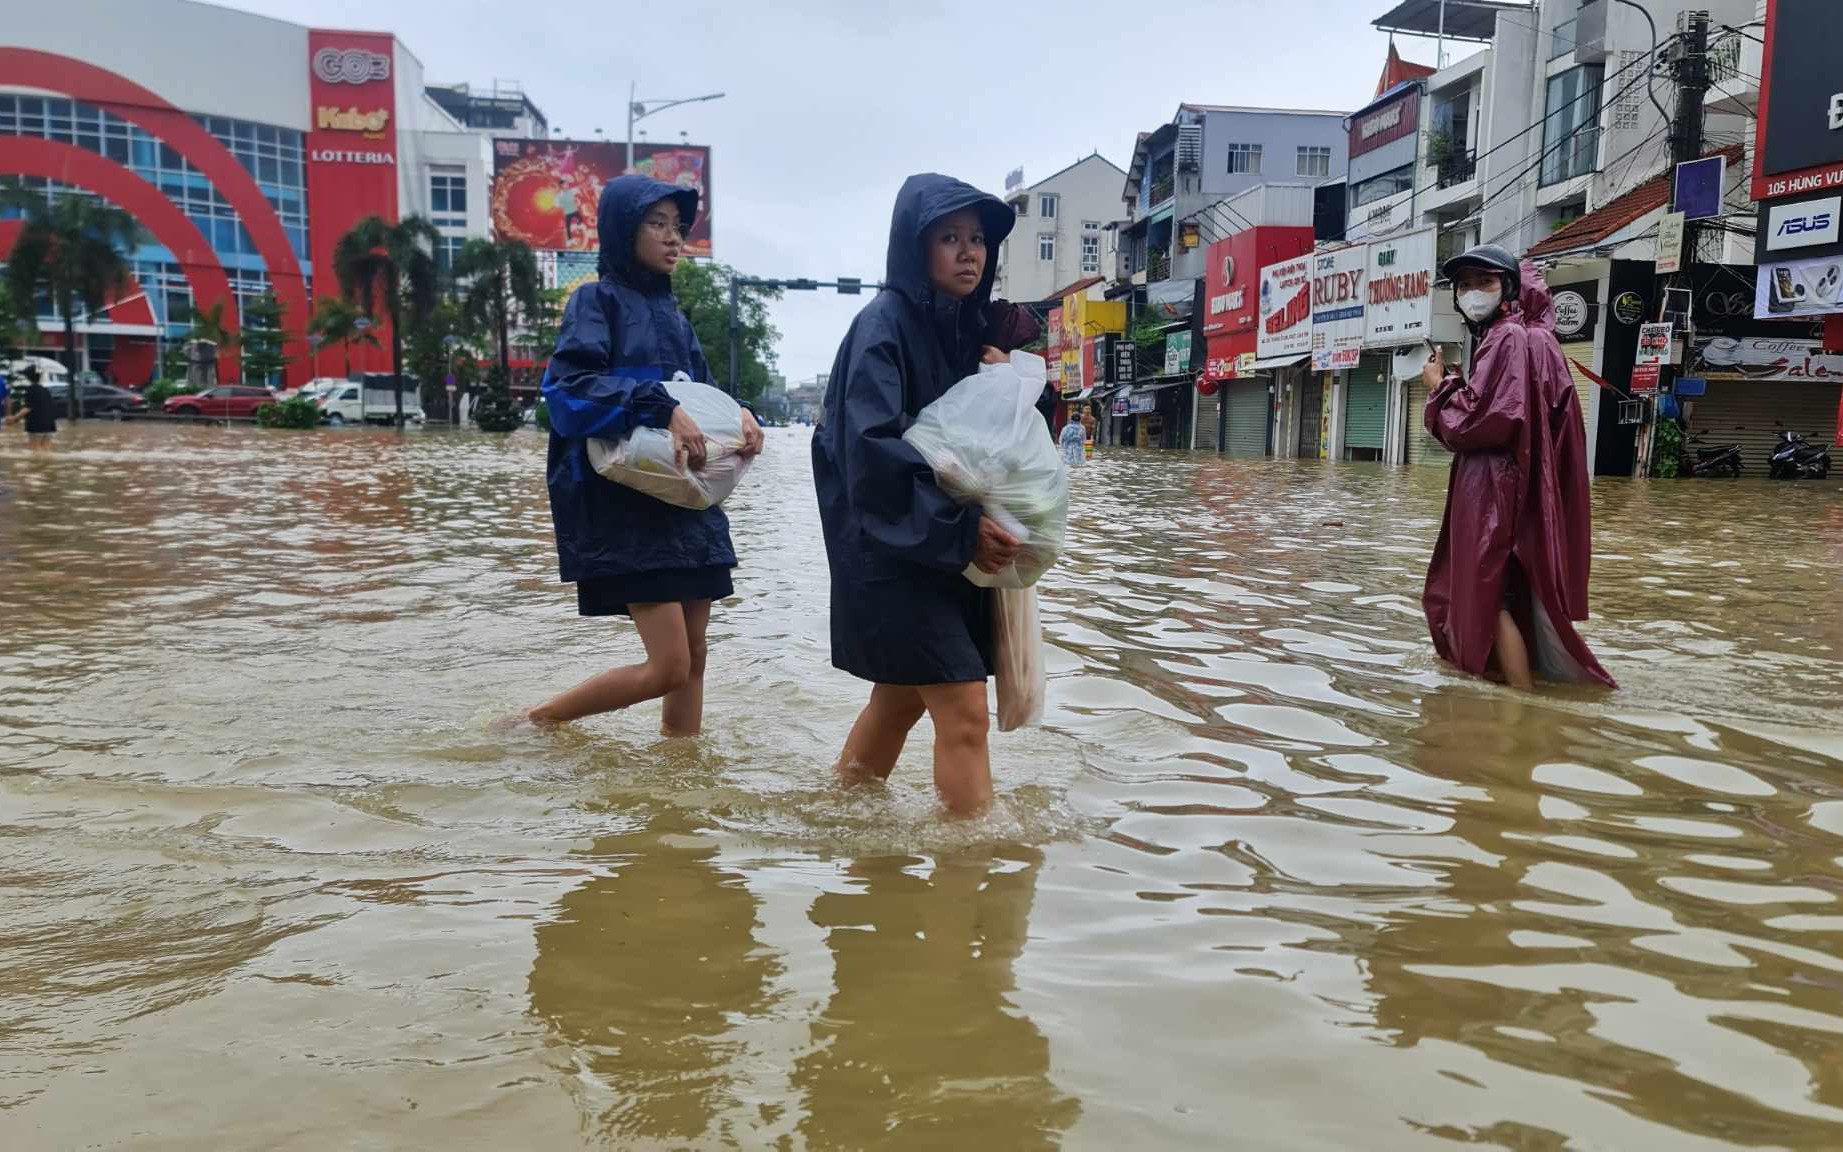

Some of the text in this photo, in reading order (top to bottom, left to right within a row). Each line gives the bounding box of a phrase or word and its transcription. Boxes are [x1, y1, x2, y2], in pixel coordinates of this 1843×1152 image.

[312, 149, 394, 164] LOTTERIA
[1767, 183, 1786, 196] 105
[1788, 174, 1822, 192] HÙNG
[1777, 214, 1831, 236] ASUS
[1313, 268, 1365, 306] RUBY
[1753, 341, 1805, 353] Coffee
